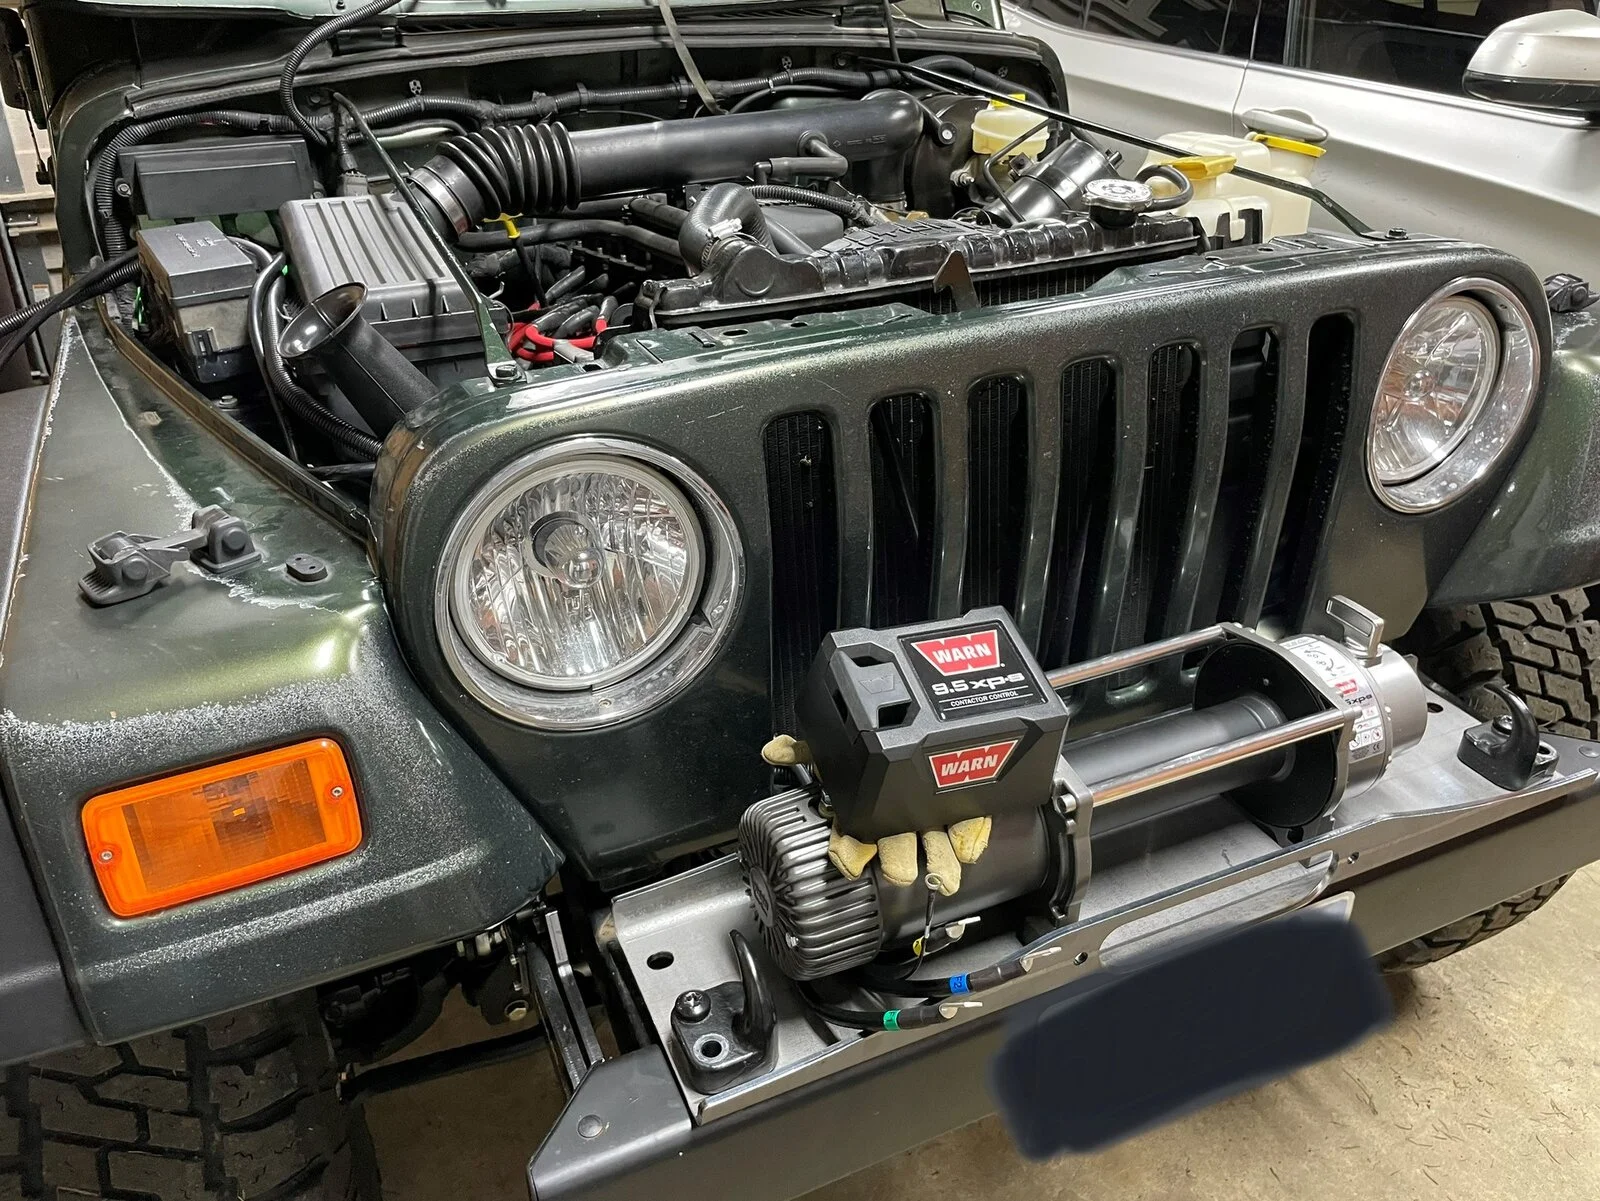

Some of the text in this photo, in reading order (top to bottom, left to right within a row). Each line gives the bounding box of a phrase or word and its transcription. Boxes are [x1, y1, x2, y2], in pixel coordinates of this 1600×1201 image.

[932, 643, 992, 664] WARN
[950, 690, 1019, 708] CONTACTOR CONTROL
[941, 753, 999, 777] WARN
